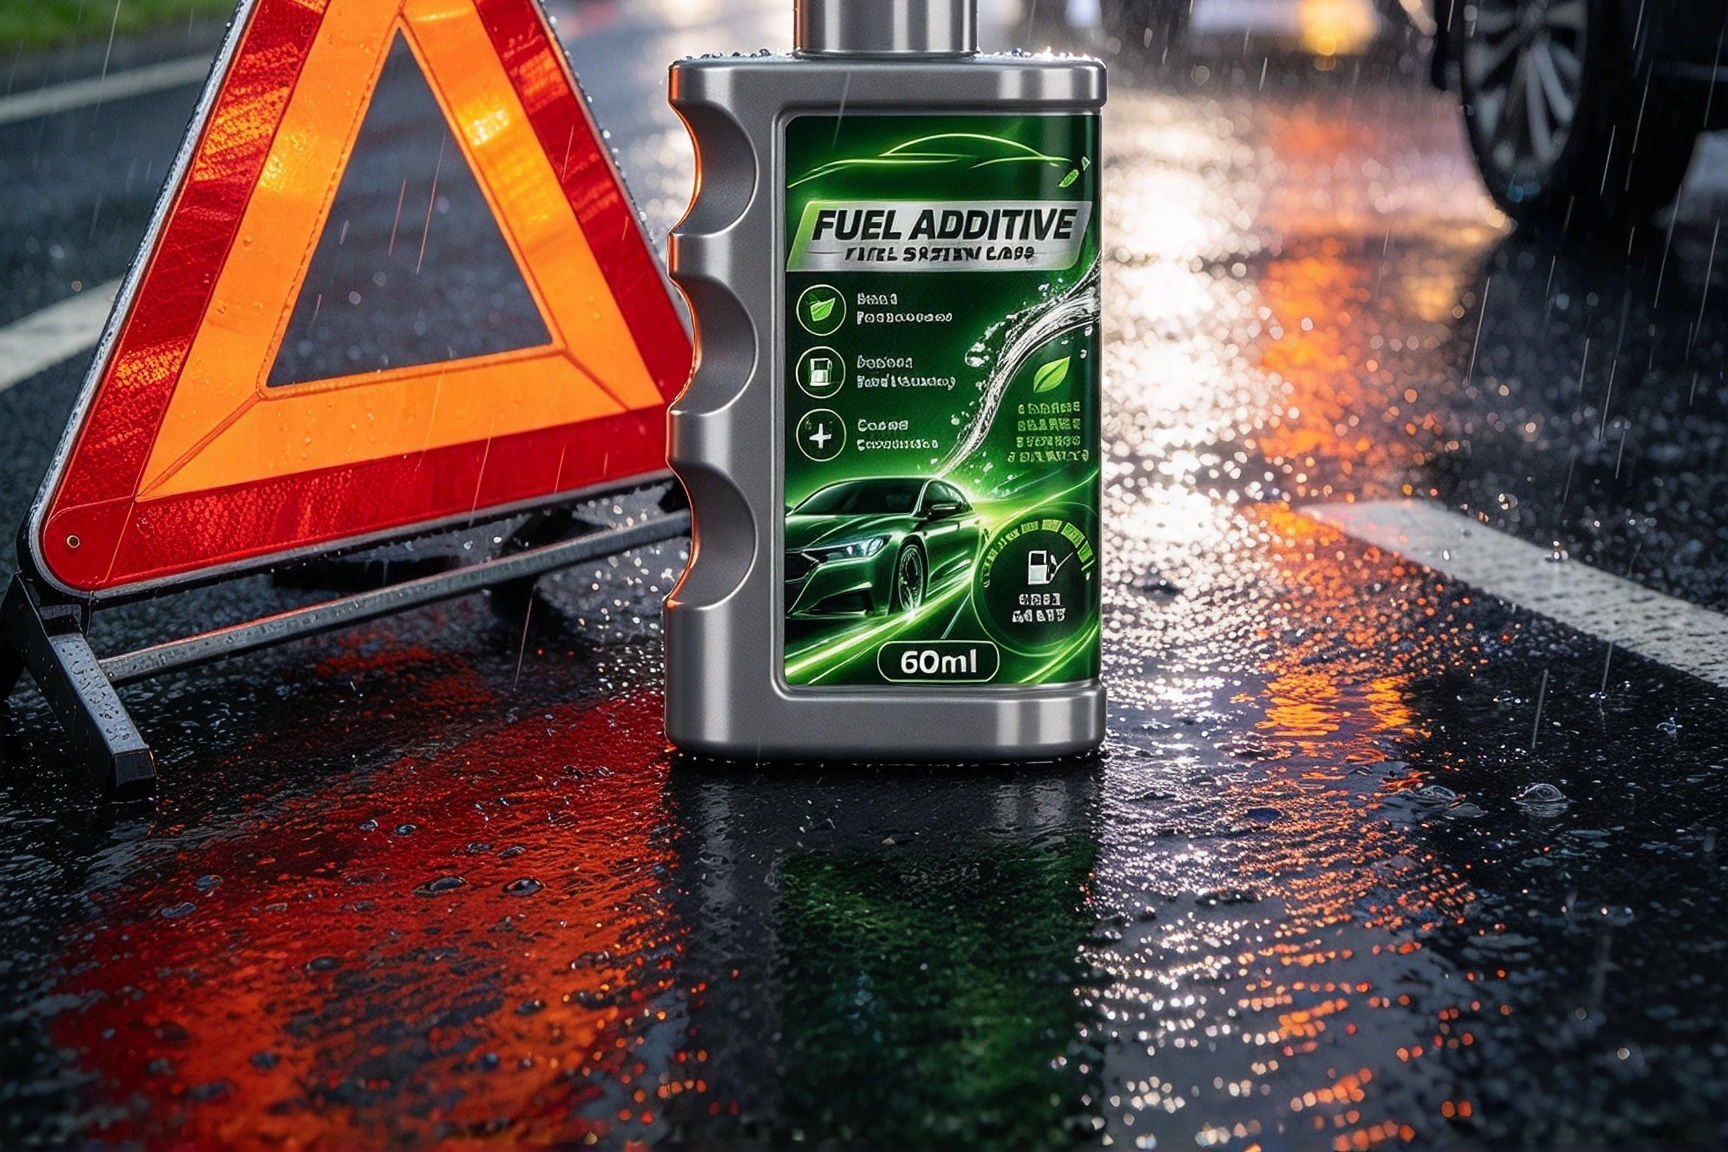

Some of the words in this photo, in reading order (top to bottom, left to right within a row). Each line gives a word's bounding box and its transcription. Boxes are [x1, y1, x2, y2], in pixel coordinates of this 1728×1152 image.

[812, 209, 902, 241] FUEL
[908, 209, 1078, 241] ADDITIVE
[900, 648, 977, 674] 60ml
